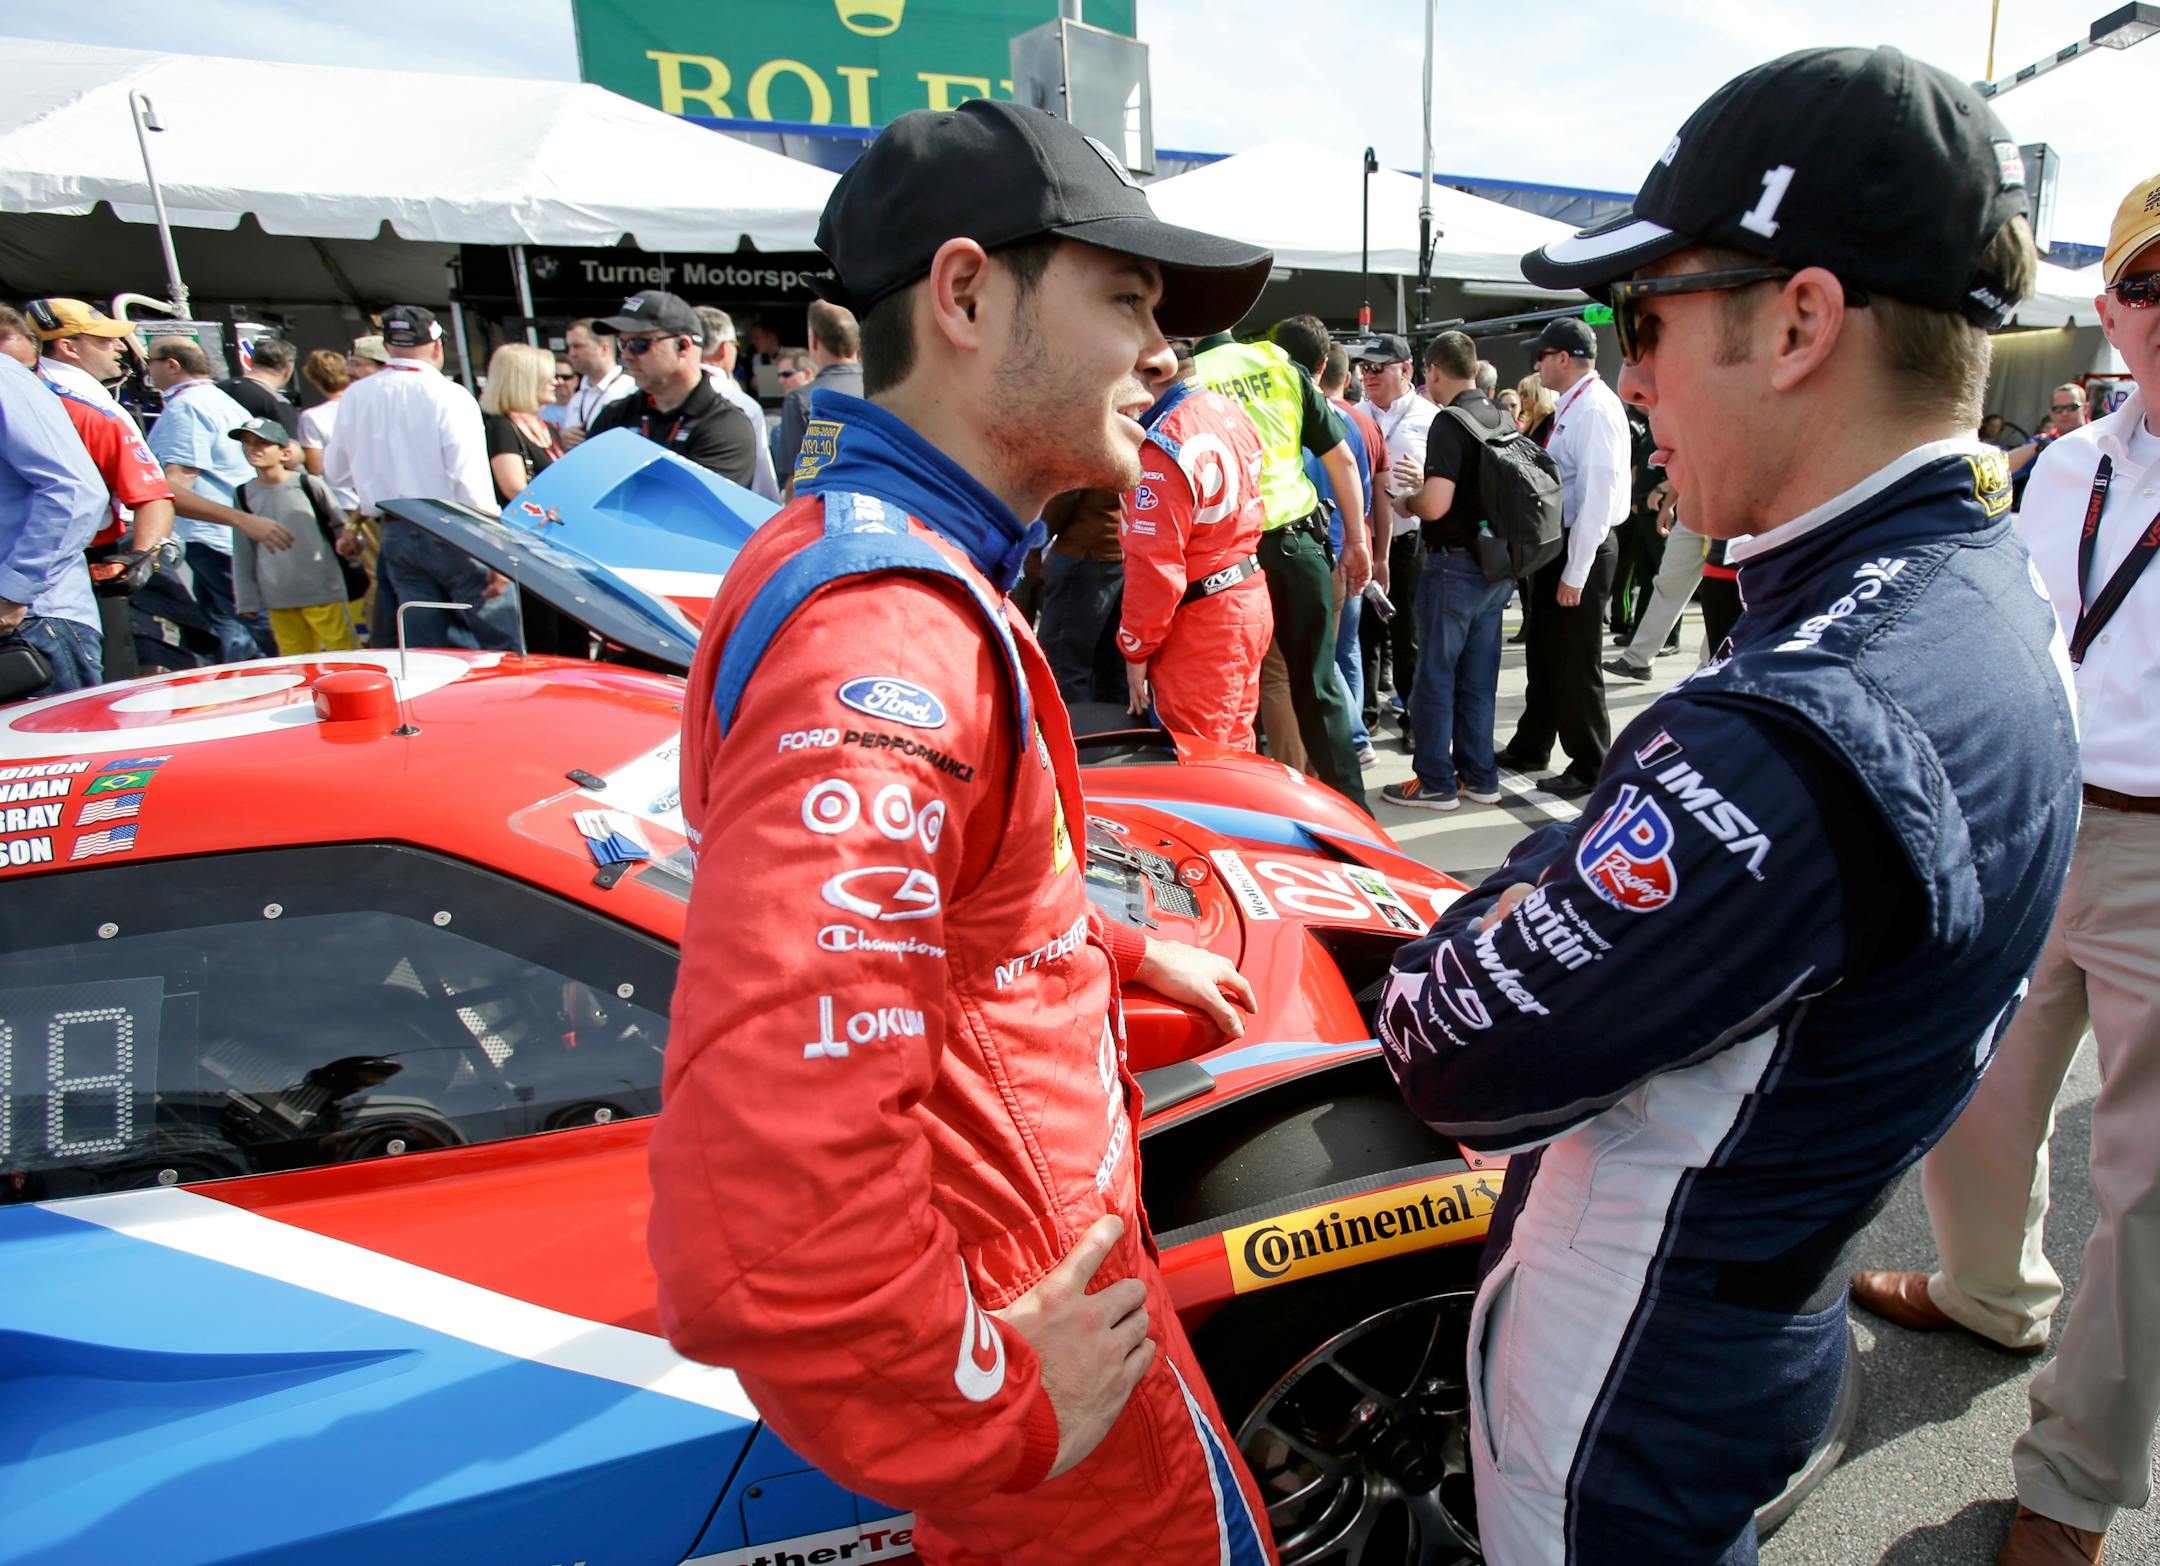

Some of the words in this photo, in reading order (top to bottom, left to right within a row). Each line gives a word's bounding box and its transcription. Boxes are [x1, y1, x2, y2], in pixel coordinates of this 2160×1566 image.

[646, 50, 1014, 129] ROLE
[1740, 164, 1796, 239] 1
[579, 259, 676, 285] Turner
[683, 261, 836, 292] Motorspot
[1208, 372, 1272, 402] ERIFF
[1142, 471, 1167, 481] MSA
[864, 681, 931, 723] Ford
[777, 728, 840, 753] FORD
[843, 730, 975, 784] PERFORMANCE
[1655, 761, 1772, 872] IMSA
[1598, 854, 1672, 904] Racing
[817, 924, 946, 963] Champion
[1244, 1185, 1474, 1279] Continental
